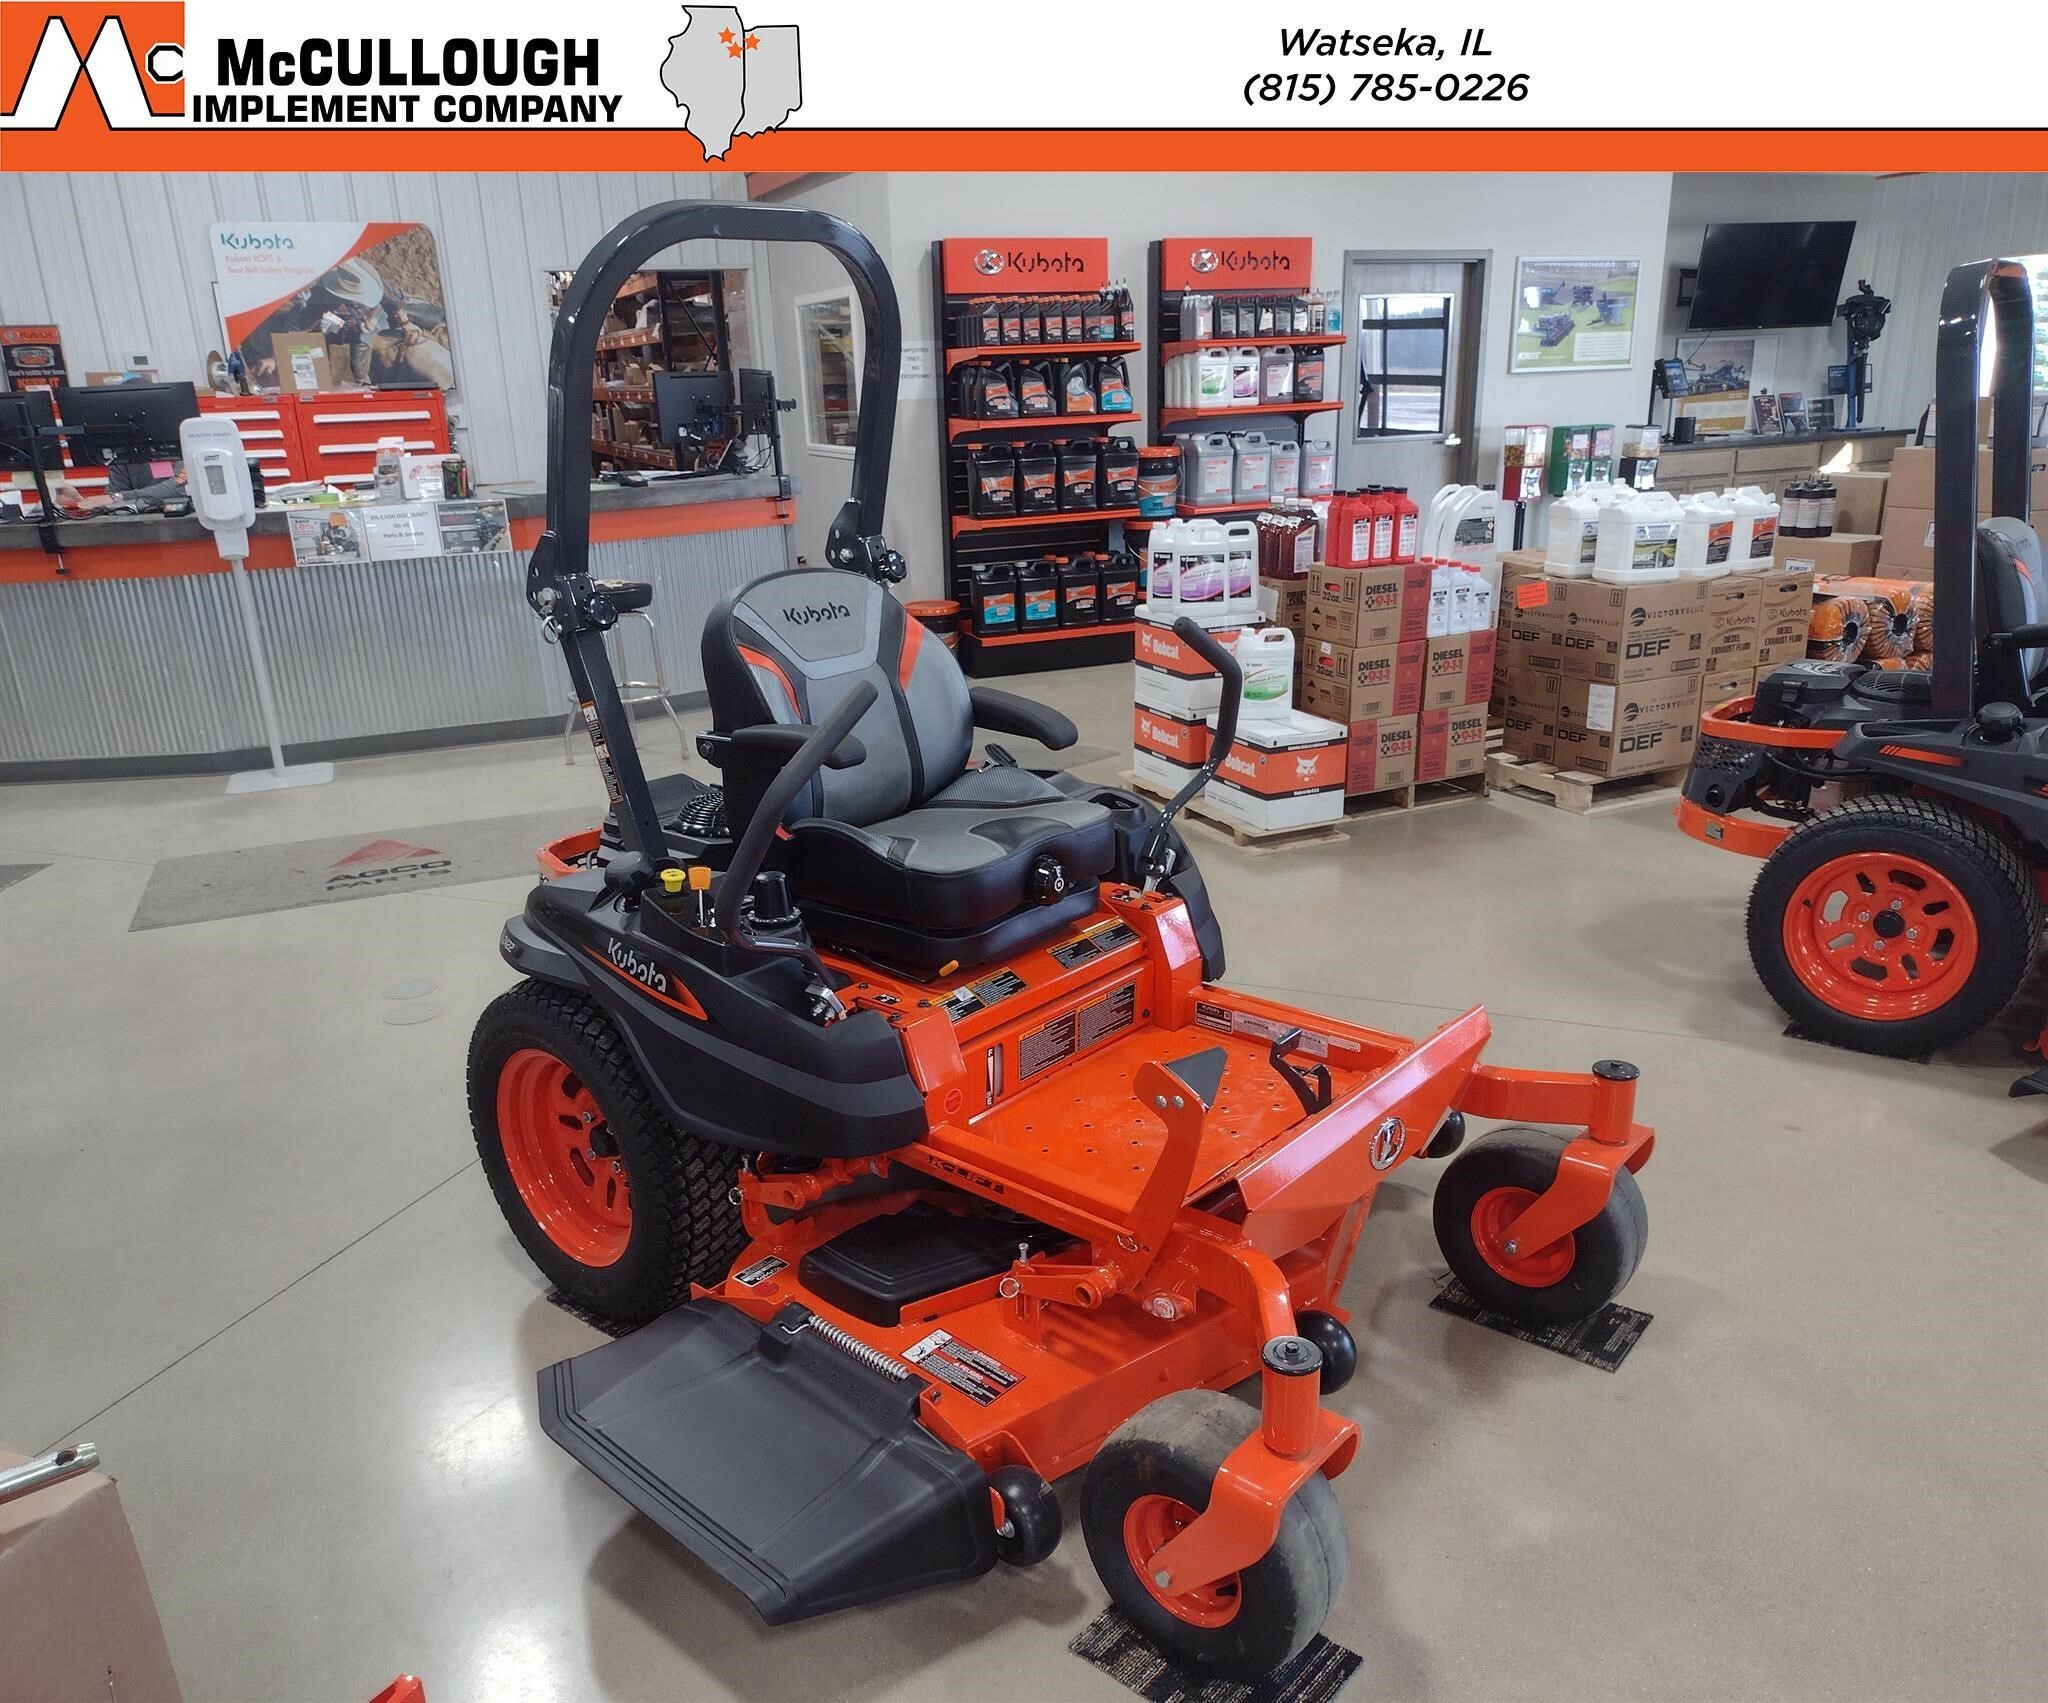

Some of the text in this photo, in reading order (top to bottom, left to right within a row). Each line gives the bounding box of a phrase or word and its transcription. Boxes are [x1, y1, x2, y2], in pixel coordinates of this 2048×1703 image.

[220, 233, 295, 250] Kubota
[1007, 251, 1085, 273] Kubota
[1220, 249, 1291, 271] Kubota
[1365, 582, 1398, 596] DIESEL
[782, 602, 851, 625] Kubota
[1726, 615, 1755, 626] Kubota
[1779, 607, 1807, 618] Kubota
[1511, 629, 1540, 642] DEF
[1564, 636, 1595, 650] DEF
[1152, 638, 1181, 660] Bobcat
[1432, 648, 1464, 662] DIESEL
[1625, 638, 1671, 660] DEF
[1358, 658, 1391, 672] DIESEL
[1451, 717, 1482, 732] DIESEL
[1505, 717, 1533, 732] DEF
[1152, 726, 1180, 749] Bobcat
[1381, 730, 1412, 743] DIESEL
[1557, 728, 1588, 743] DEF
[1619, 731, 1663, 754] DEF
[1224, 752, 1257, 778] Bobcat
[325, 860, 452, 884] AGCO
[326, 869, 452, 891] PARTS
[607, 937, 667, 993] Kubota
